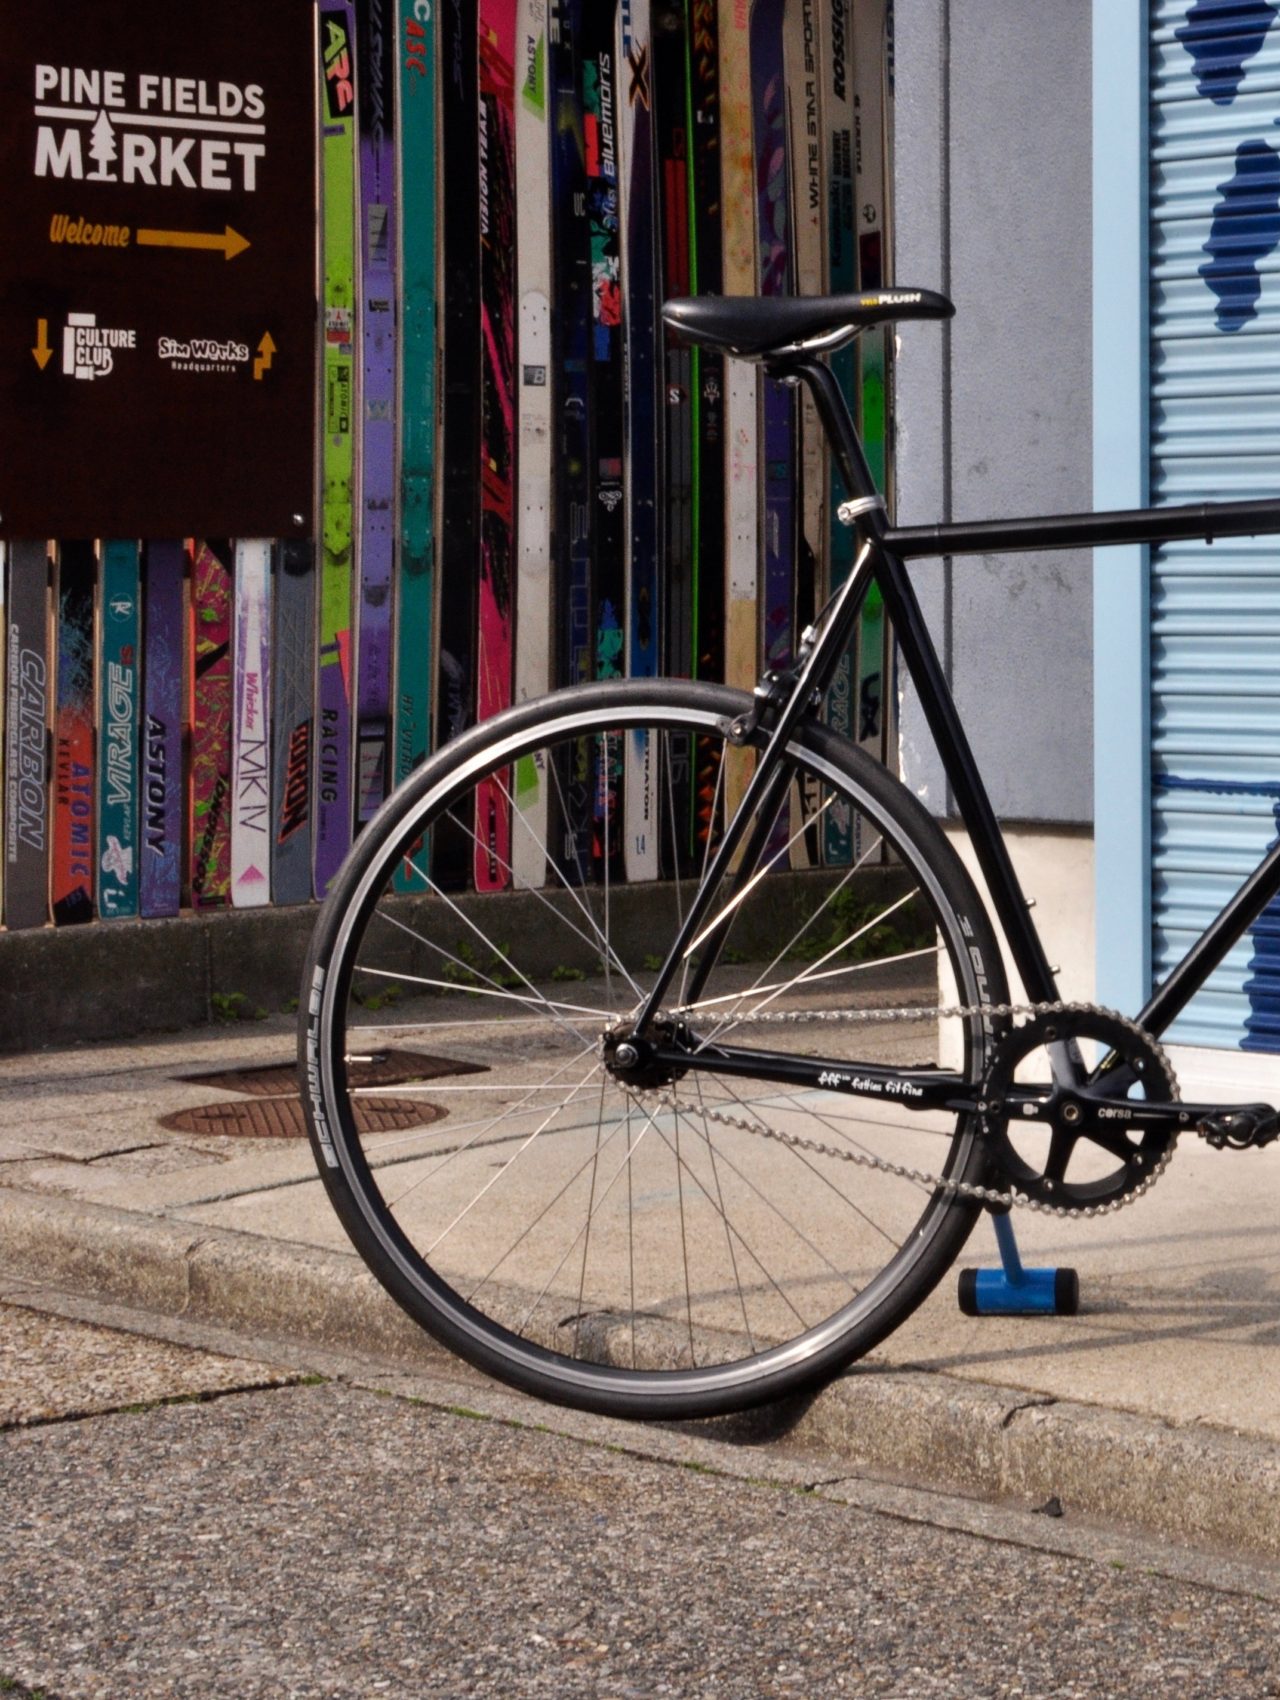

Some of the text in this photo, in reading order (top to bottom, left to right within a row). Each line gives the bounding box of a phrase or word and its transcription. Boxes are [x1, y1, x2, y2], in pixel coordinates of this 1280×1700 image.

[35, 64, 266, 118] PINE FIELDS
[527, 35, 537, 95] ASTONY
[50, 214, 130, 247] Welcome
[878, 292, 922, 306] PLUSH
[76, 328, 136, 348] CULTURE
[76, 347, 113, 375] CLUB
[171, 361, 236, 372] Headquarters
[8, 624, 19, 863] CARBON FIBERGLASS COMPOSITE
[18, 648, 46, 851] CARBON
[107, 660, 133, 806] VIRAGE
[320, 708, 338, 803] RACING
[58, 739, 70, 805] KEVLAR
[145, 714, 166, 857] ASTONY
[70, 762, 90, 876] ATOMIC
[306, 964, 340, 1168] SCHWALBE
